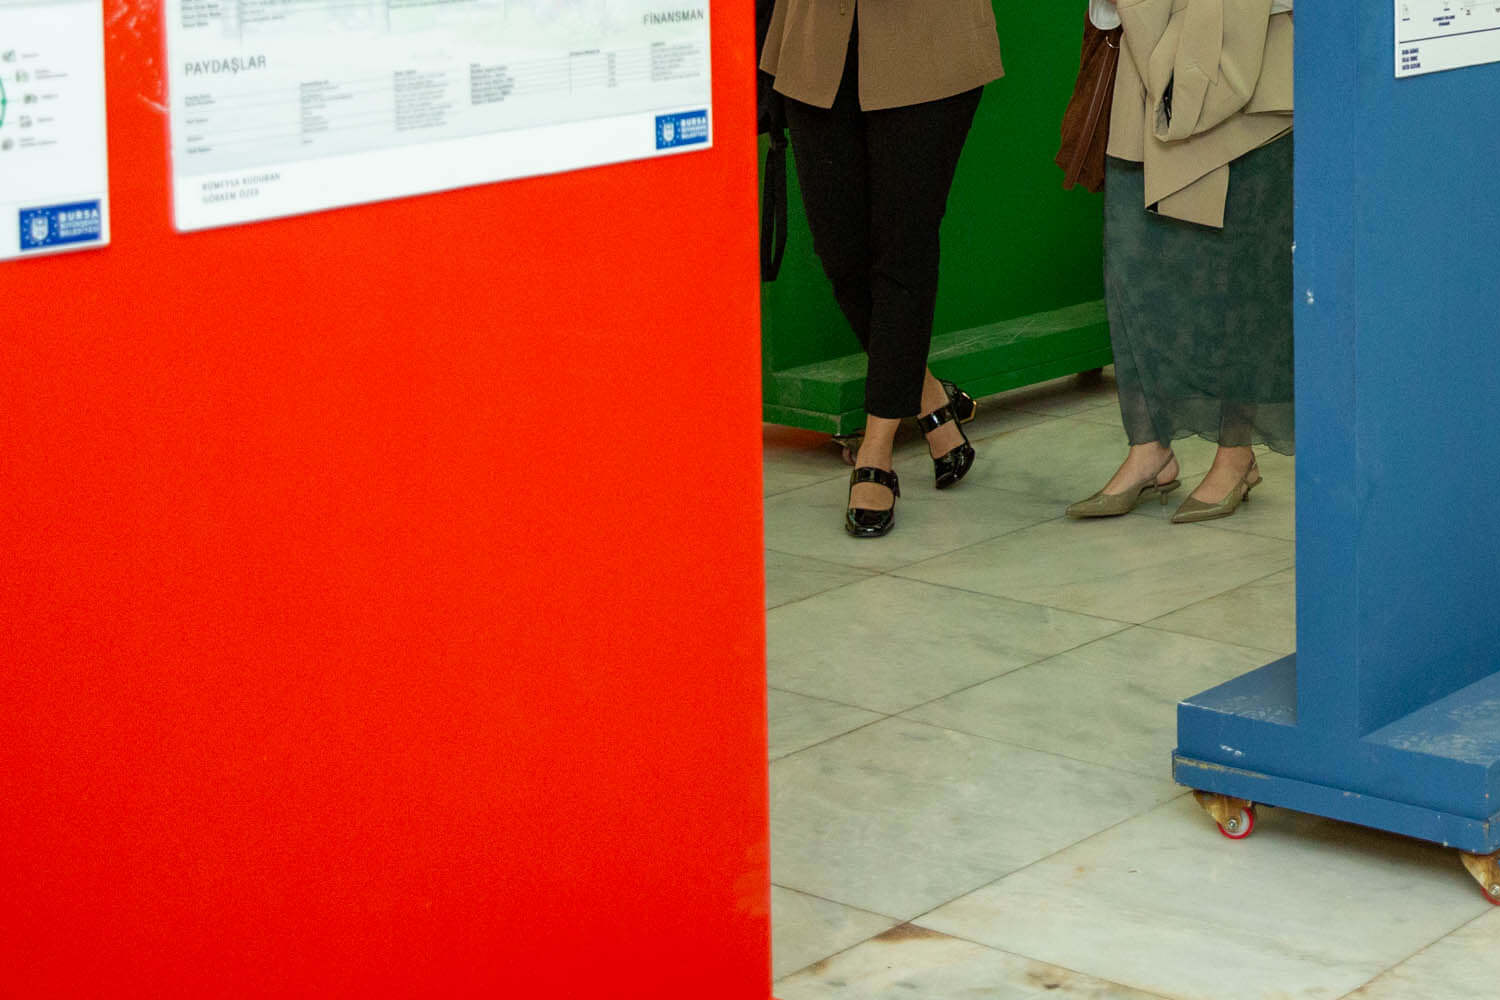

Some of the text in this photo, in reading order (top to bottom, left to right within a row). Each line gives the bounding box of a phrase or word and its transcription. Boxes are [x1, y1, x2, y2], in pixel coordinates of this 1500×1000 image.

[643, 9, 704, 26] FİNANSMAN
[184, 55, 267, 77] PAYDAŞLAR
[59, 209, 99, 222] BURSA
